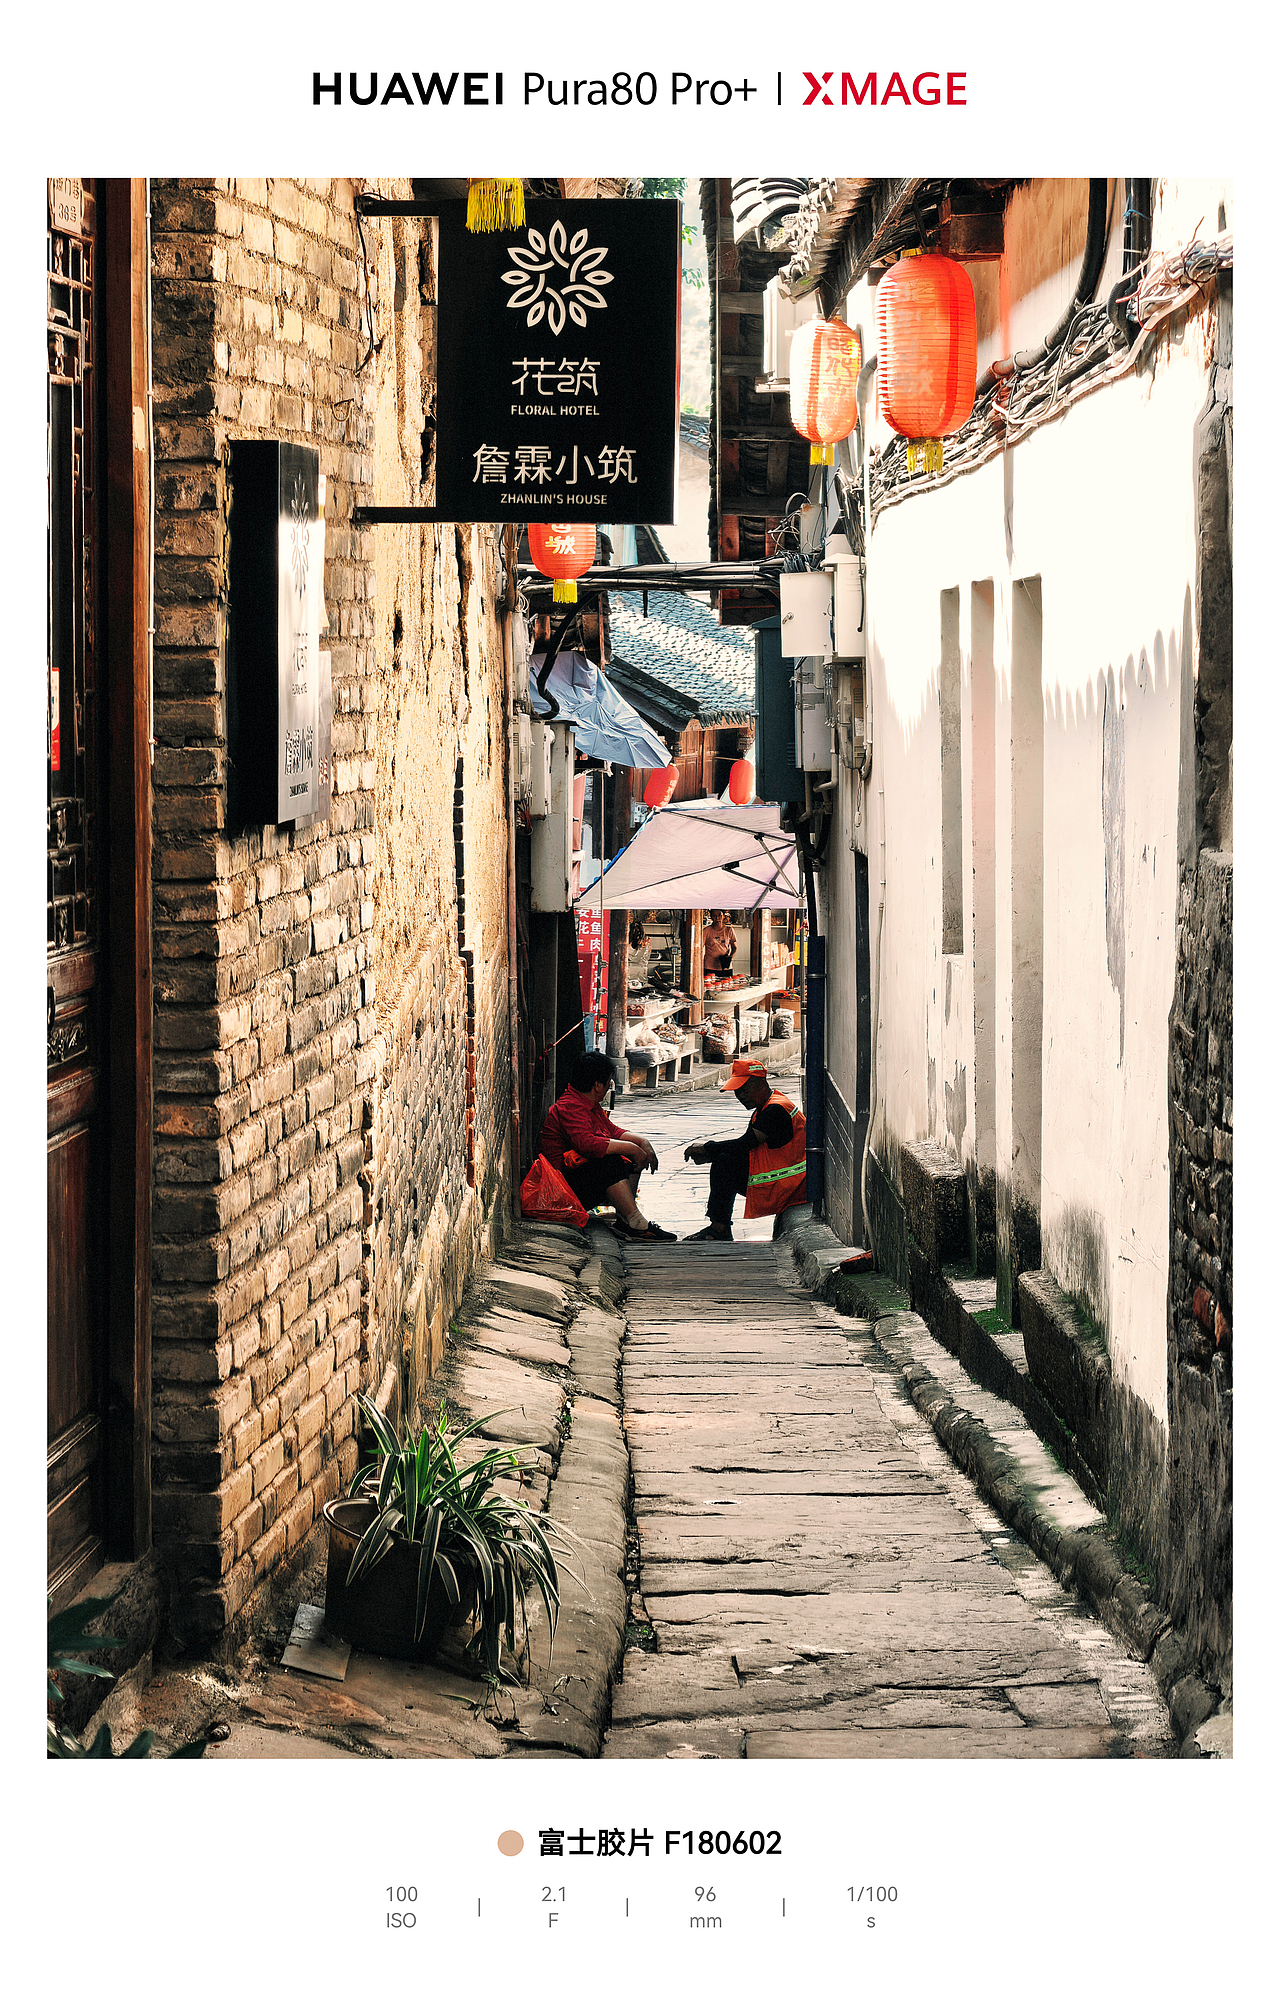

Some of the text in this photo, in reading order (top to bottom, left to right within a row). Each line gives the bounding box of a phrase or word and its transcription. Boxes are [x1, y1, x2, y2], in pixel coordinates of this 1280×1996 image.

[511, 356, 601, 396] 花筑
[511, 405, 600, 416] FLORAL HOTEL
[472, 443, 638, 485] 詹霖小筑
[500, 493, 608, 505] ZHANLIN'S HOUSE
